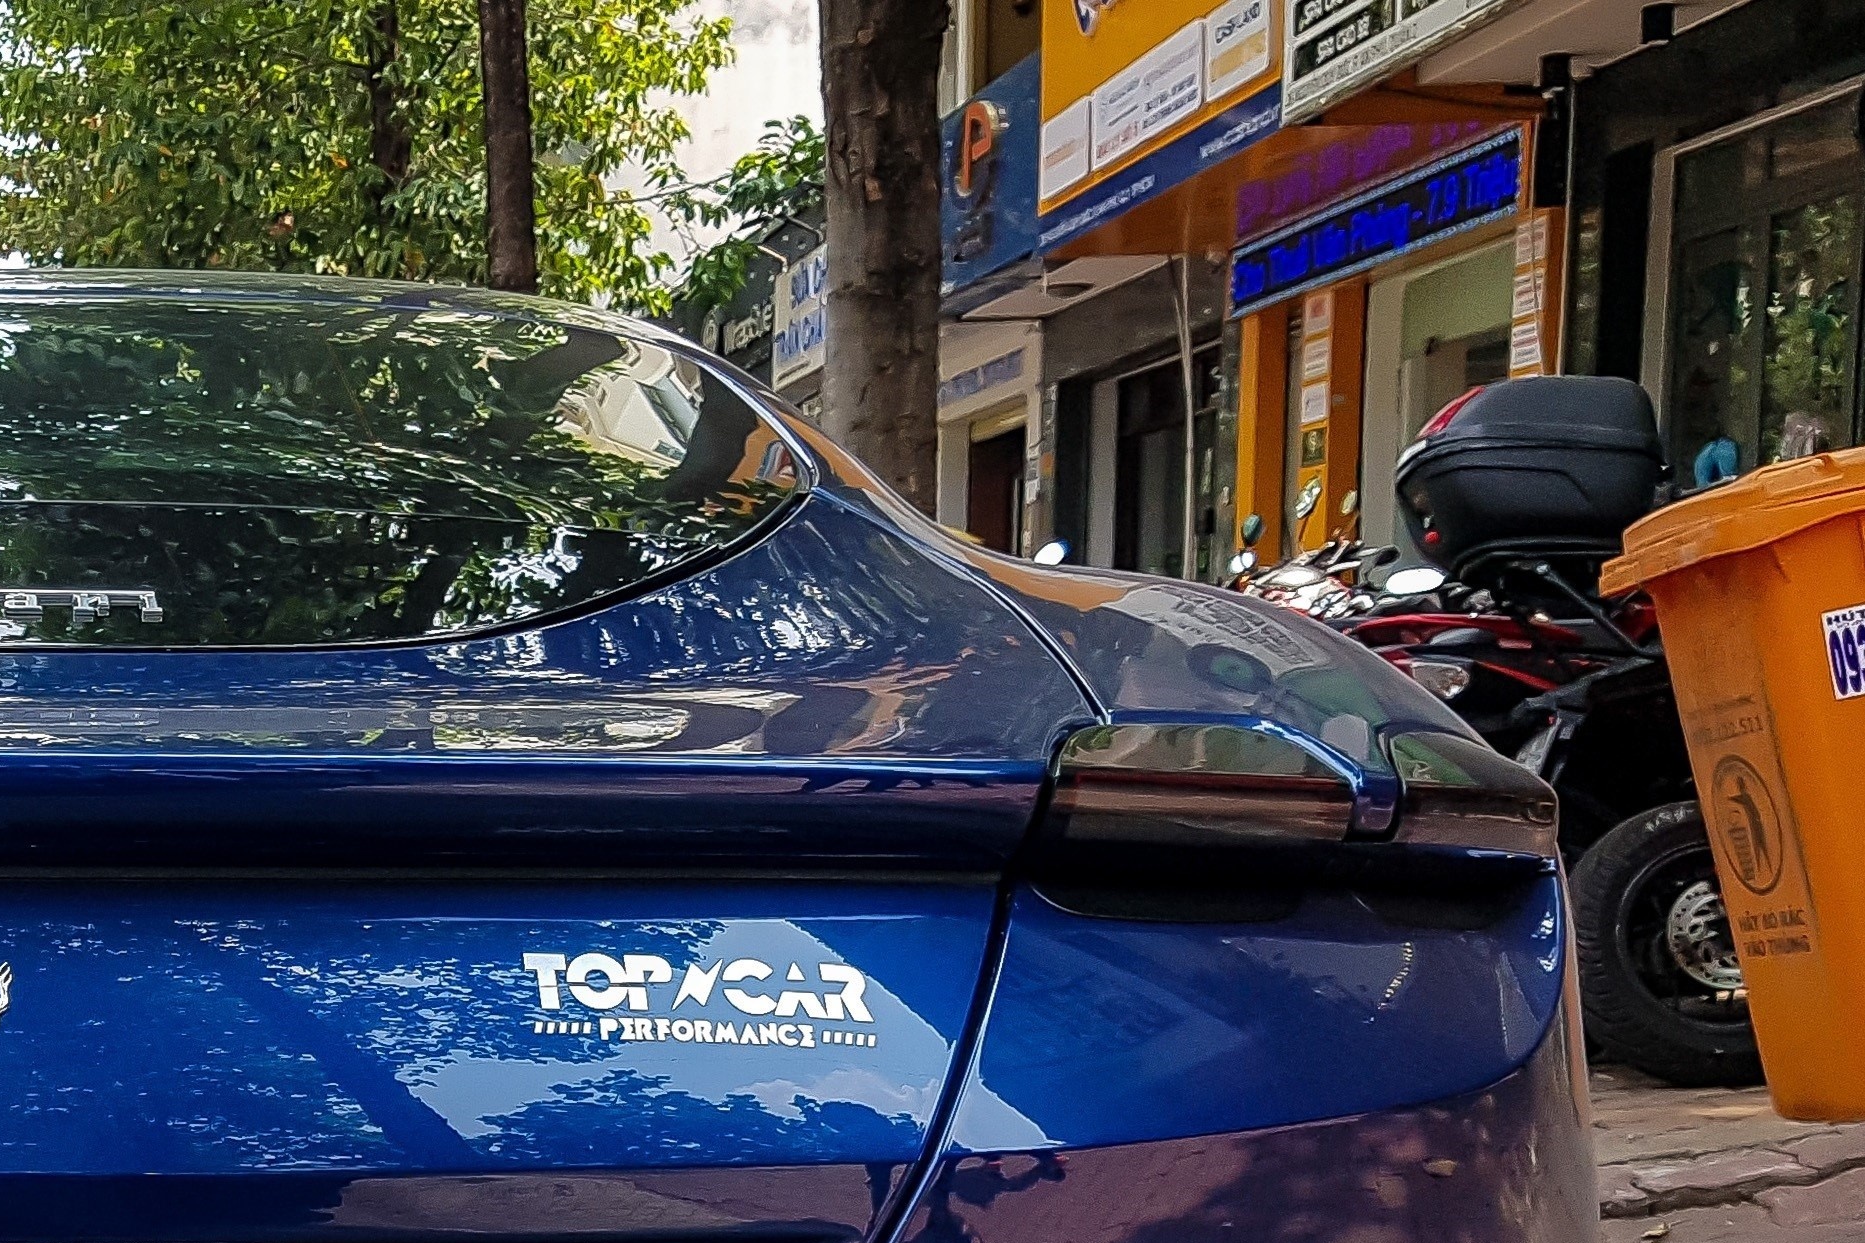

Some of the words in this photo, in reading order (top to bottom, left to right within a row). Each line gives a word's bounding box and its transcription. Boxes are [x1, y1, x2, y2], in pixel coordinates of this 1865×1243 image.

[523, 952, 673, 1010] TOP
[722, 957, 876, 1023] CAR
[599, 1017, 817, 1048] PERFORMANCE
